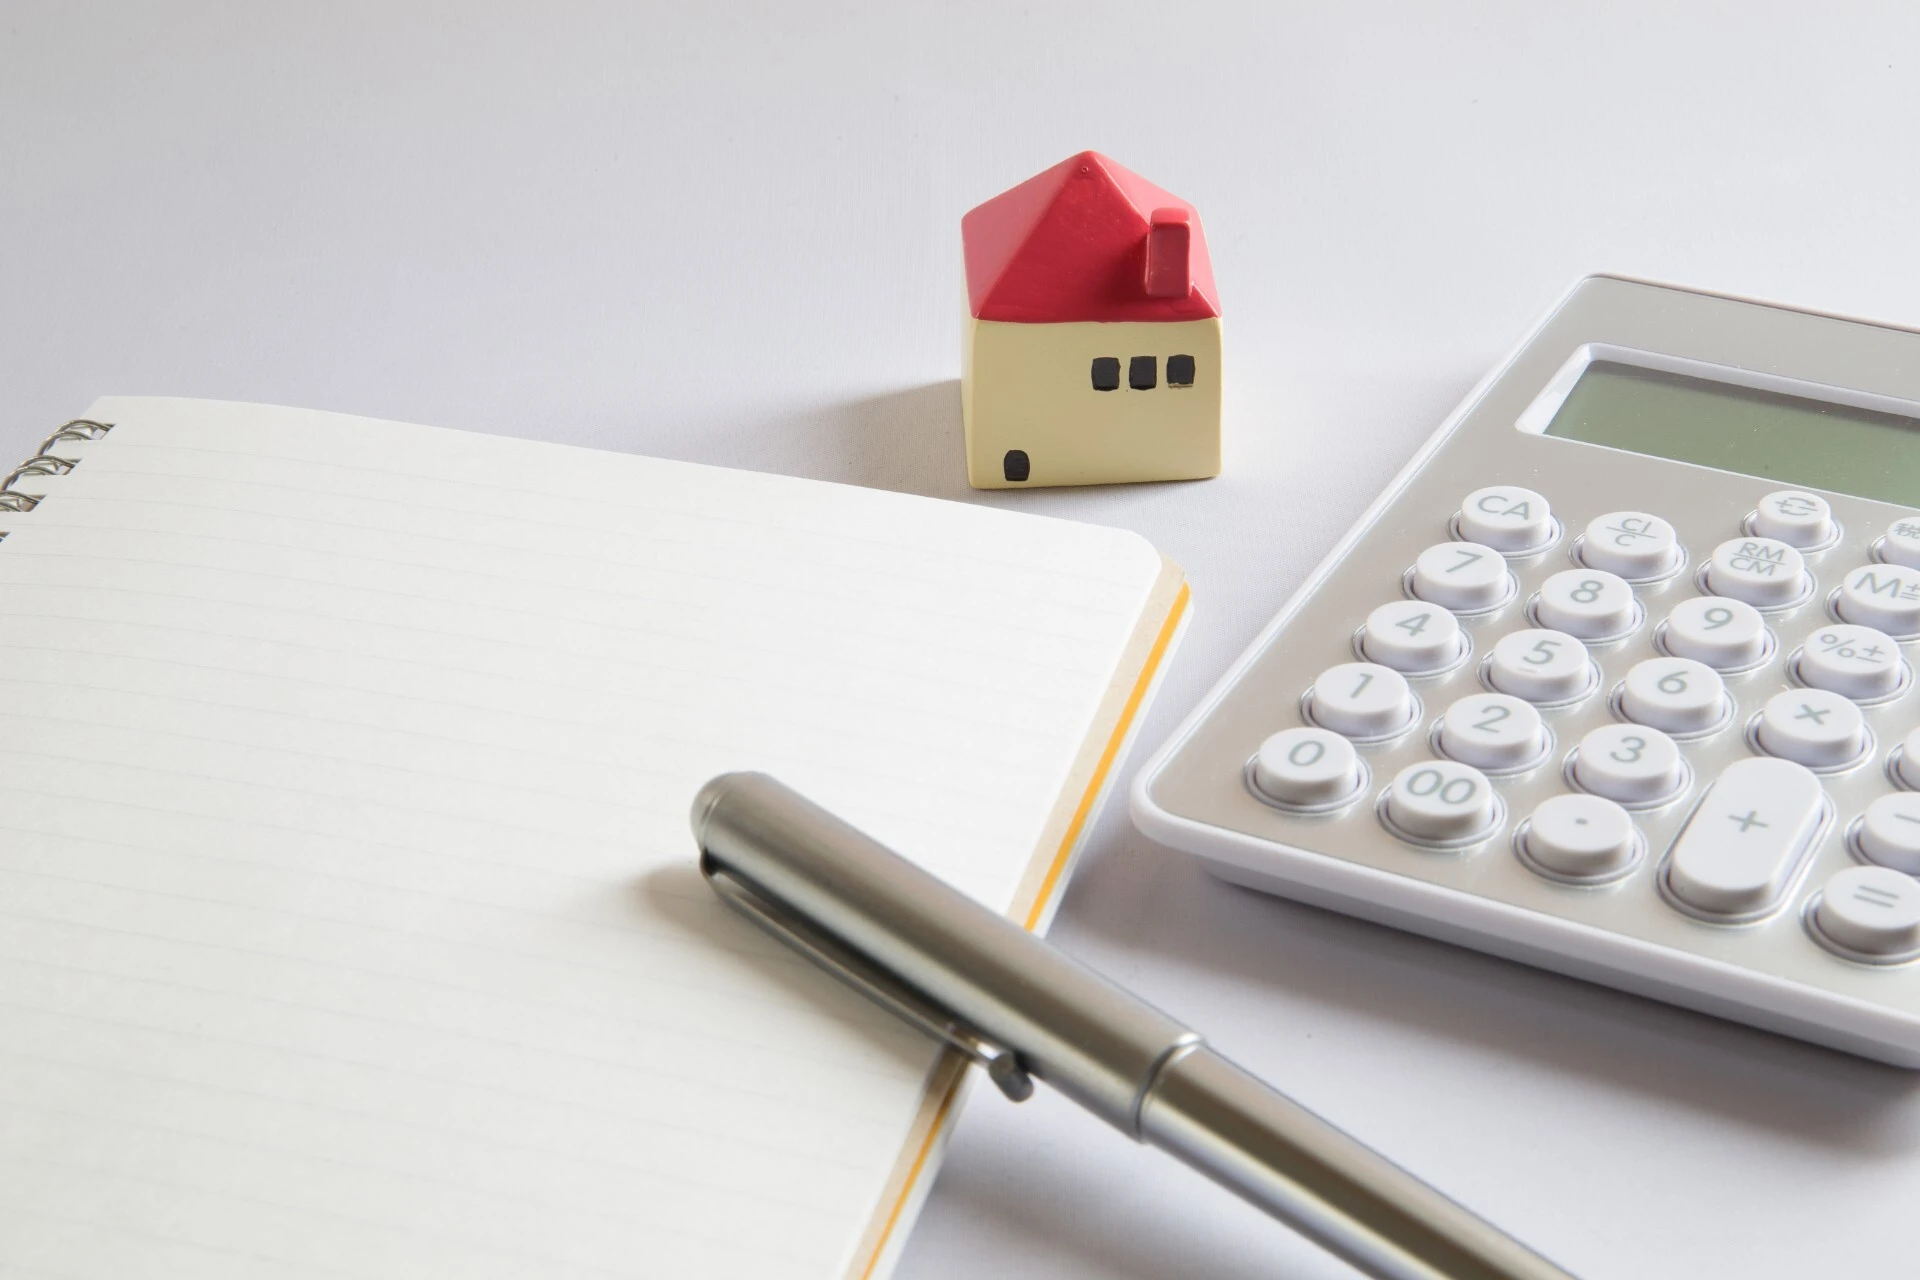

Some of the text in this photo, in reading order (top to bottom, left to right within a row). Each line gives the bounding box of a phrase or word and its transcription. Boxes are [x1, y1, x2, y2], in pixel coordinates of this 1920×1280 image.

[1477, 495, 1530, 520] CA
[1614, 533, 1637, 547] C
[1738, 541, 1786, 562] RM
[1445, 550, 1484, 574] 7
[1728, 557, 1777, 577] CM
[1570, 579, 1605, 604] 8
[1395, 612, 1432, 637] 4
[1703, 607, 1734, 631] 9
[1522, 639, 1563, 665] 5
[1349, 672, 1375, 699] 1
[1657, 670, 1689, 694] 6
[1471, 705, 1512, 734] 2
[1288, 740, 1326, 767] 0
[1609, 736, 1647, 764] 3
[1406, 769, 1477, 805] 00
[1852, 885, 1900, 909] =
